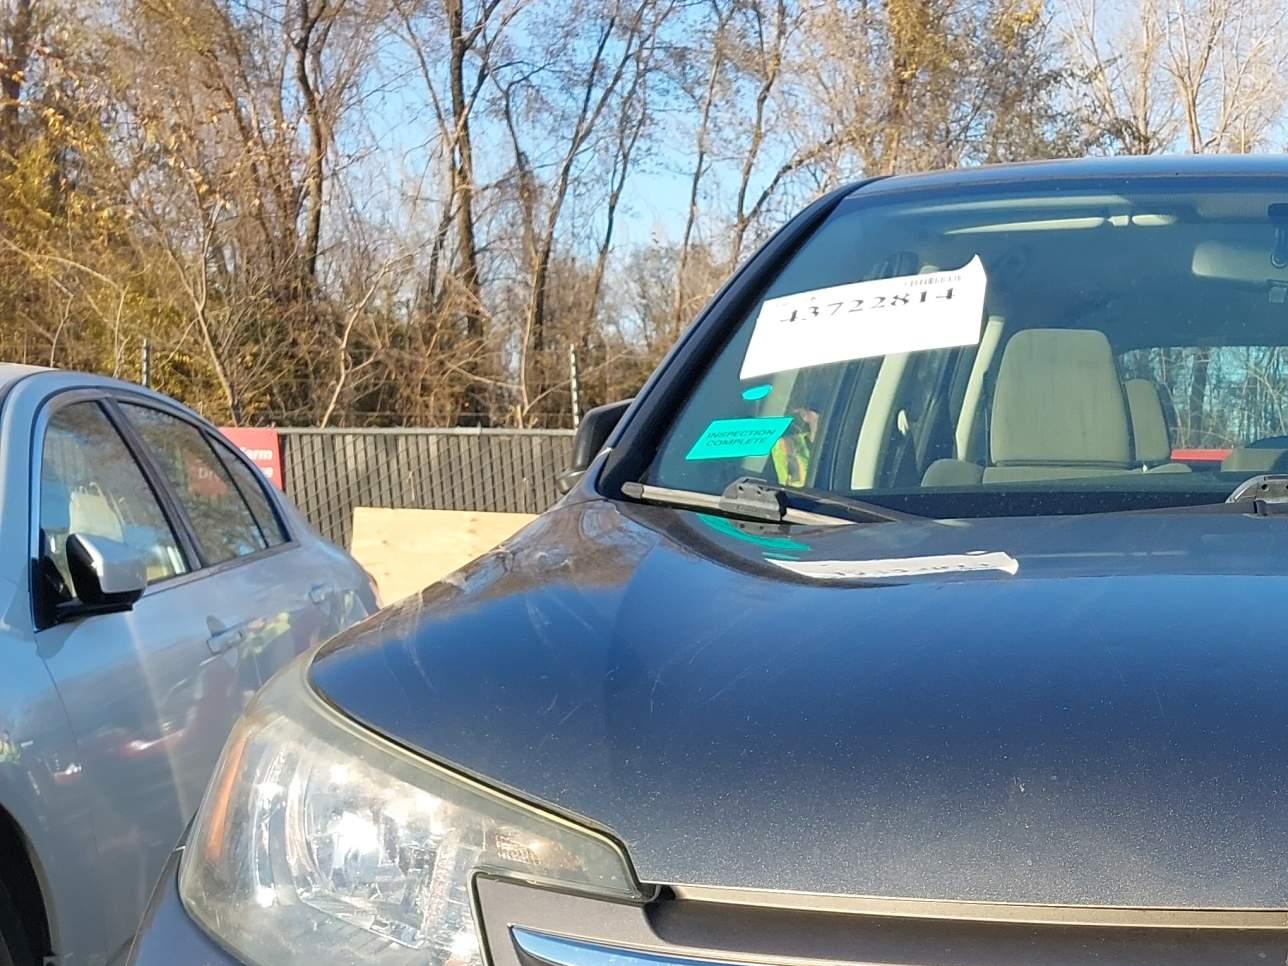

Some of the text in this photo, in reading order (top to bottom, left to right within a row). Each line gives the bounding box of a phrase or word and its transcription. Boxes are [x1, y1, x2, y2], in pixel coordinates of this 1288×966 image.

[779, 287, 955, 323] 43722814
[706, 429, 776, 438] INSPECTION
[706, 437, 767, 447] COMPLETE
